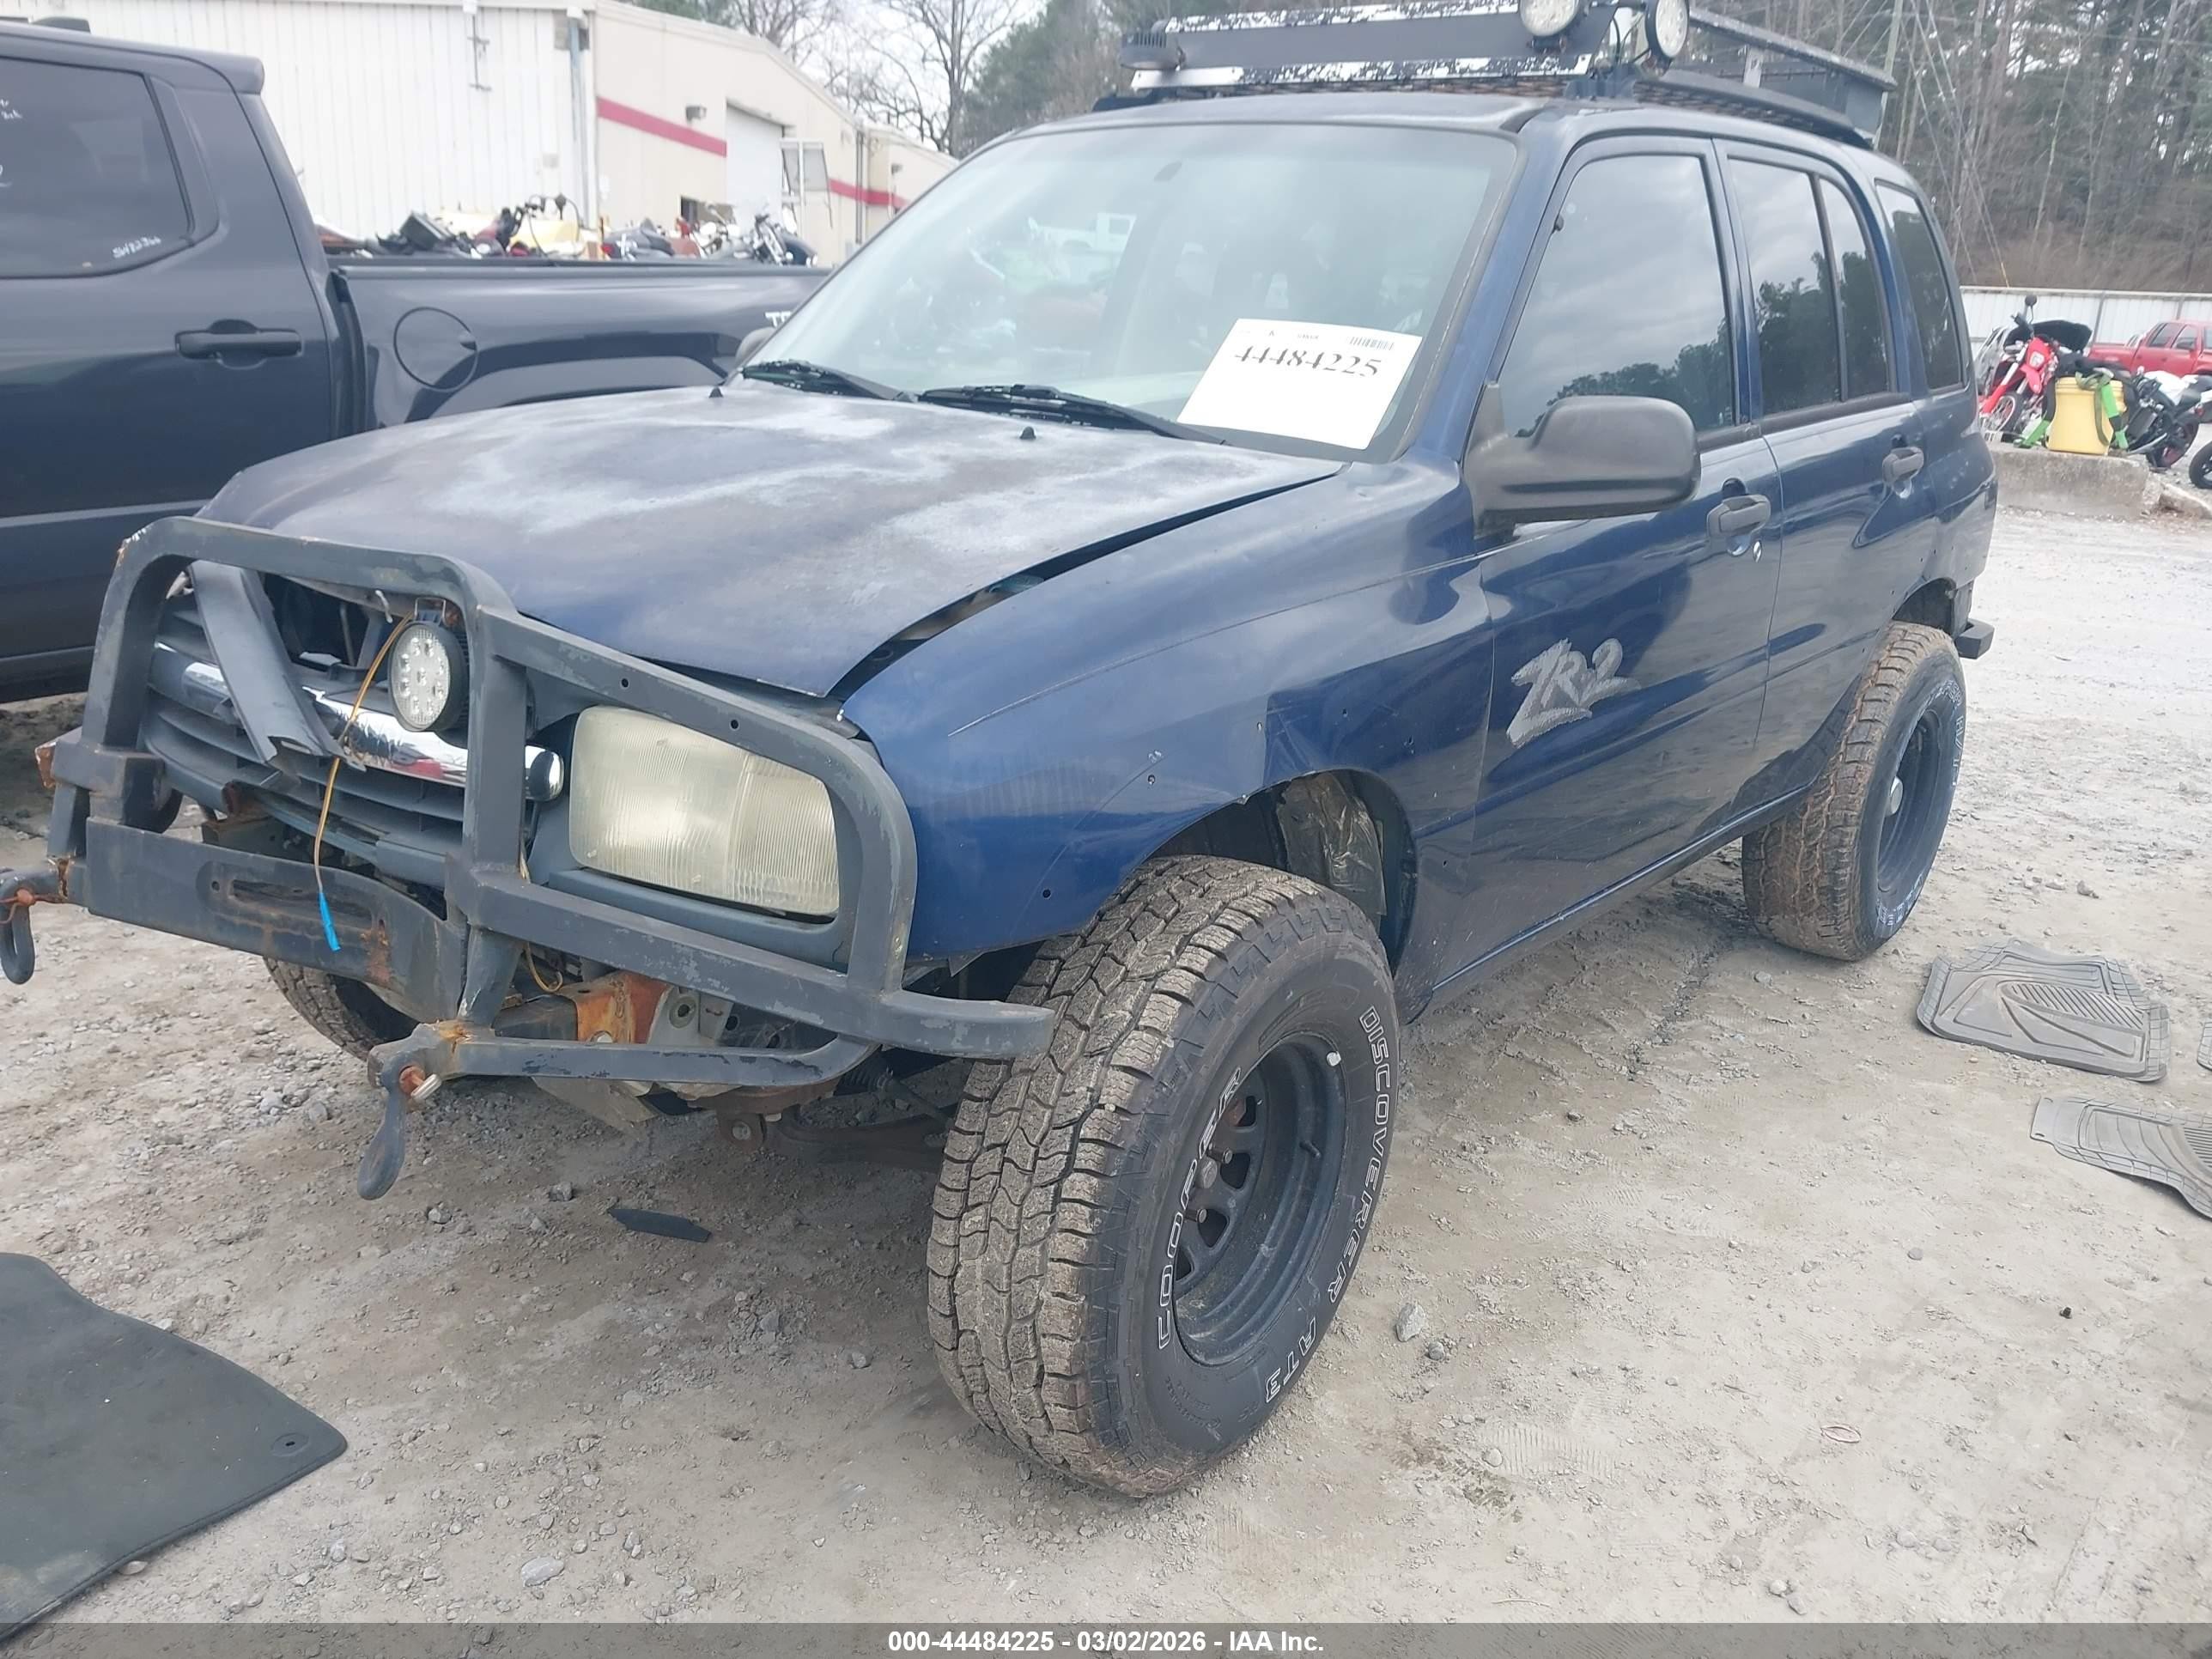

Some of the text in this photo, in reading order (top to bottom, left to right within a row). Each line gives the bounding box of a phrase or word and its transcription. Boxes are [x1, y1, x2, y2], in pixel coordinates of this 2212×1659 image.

[1234, 345, 1382, 377] 44484225
[1506, 637, 1642, 749] ZR2
[1158, 1066, 1242, 1350] COOPER
[1327, 1006, 1390, 1305] DISCOVERER
